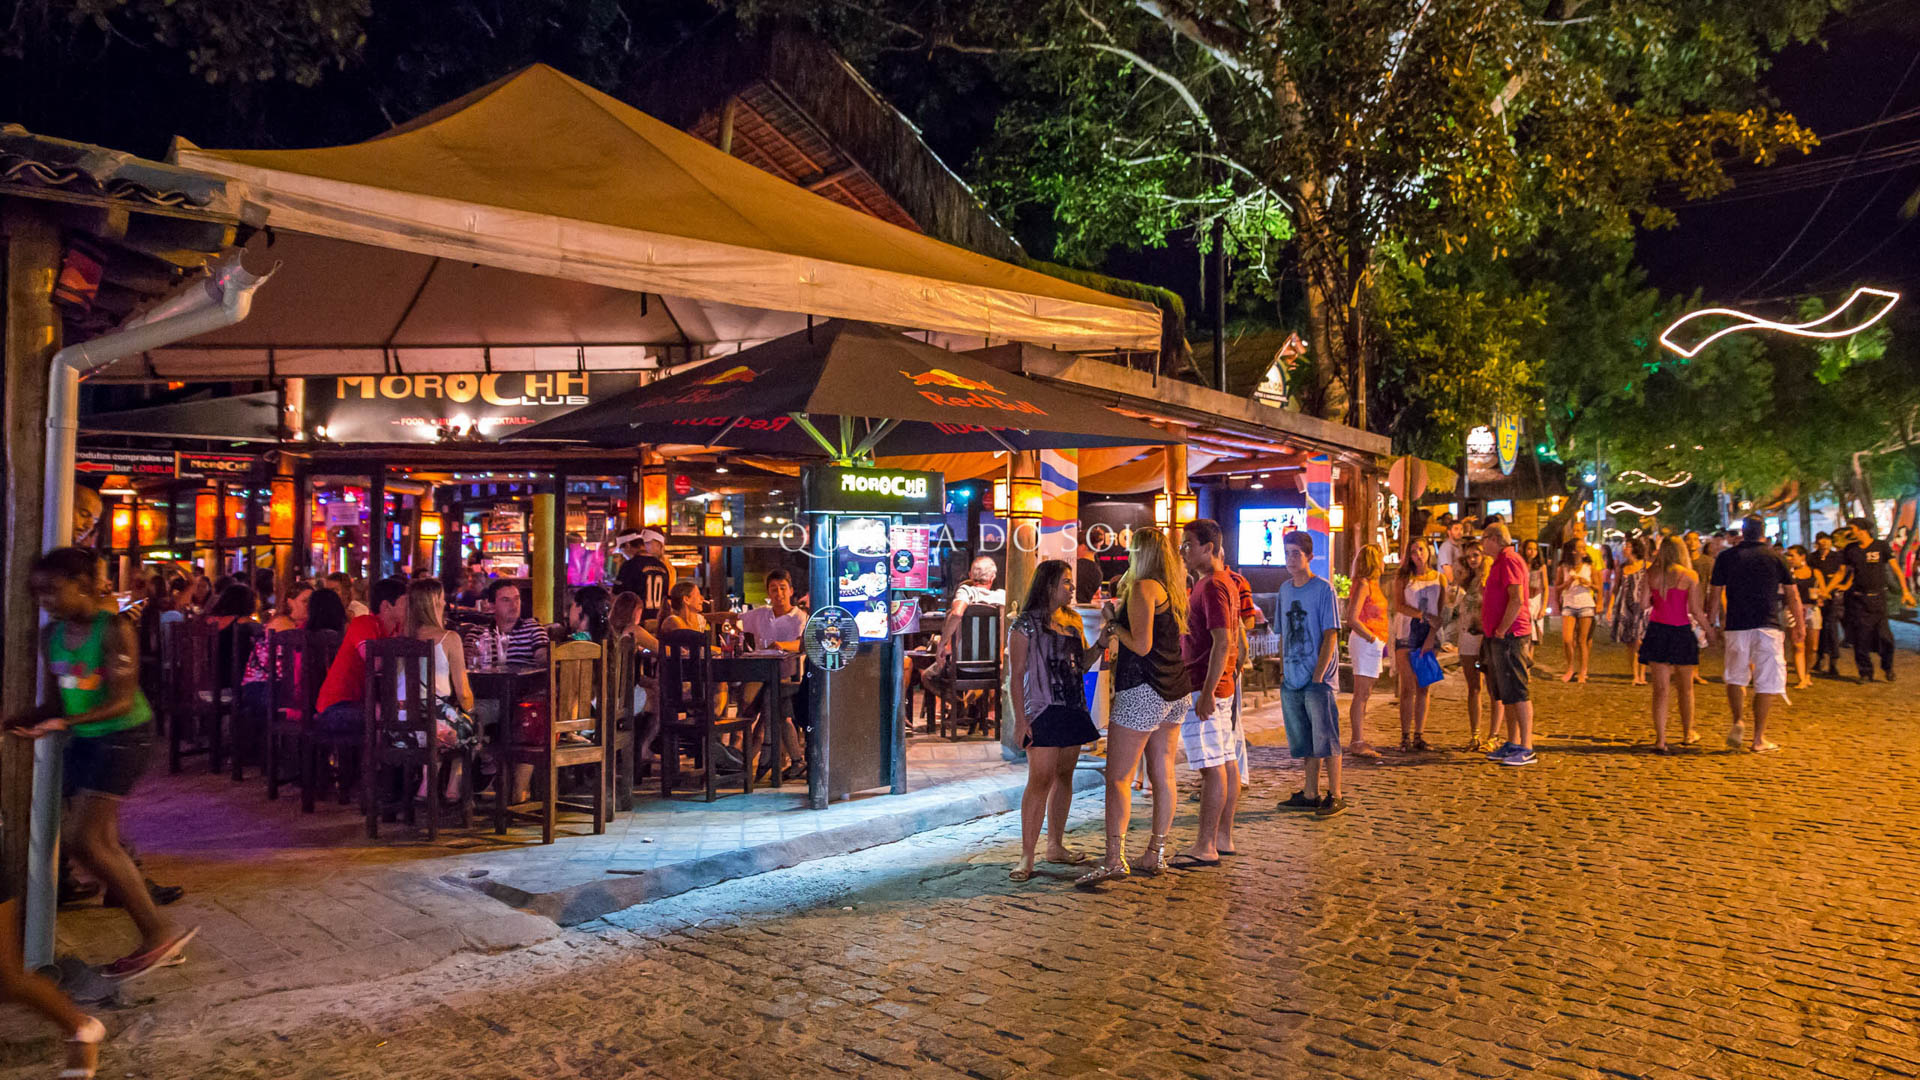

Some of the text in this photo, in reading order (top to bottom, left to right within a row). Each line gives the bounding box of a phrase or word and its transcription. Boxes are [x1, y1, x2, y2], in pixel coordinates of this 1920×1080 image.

[918, 390, 990, 408] Red
[114, 464, 131, 472] bar
[645, 574, 663, 609] 10
